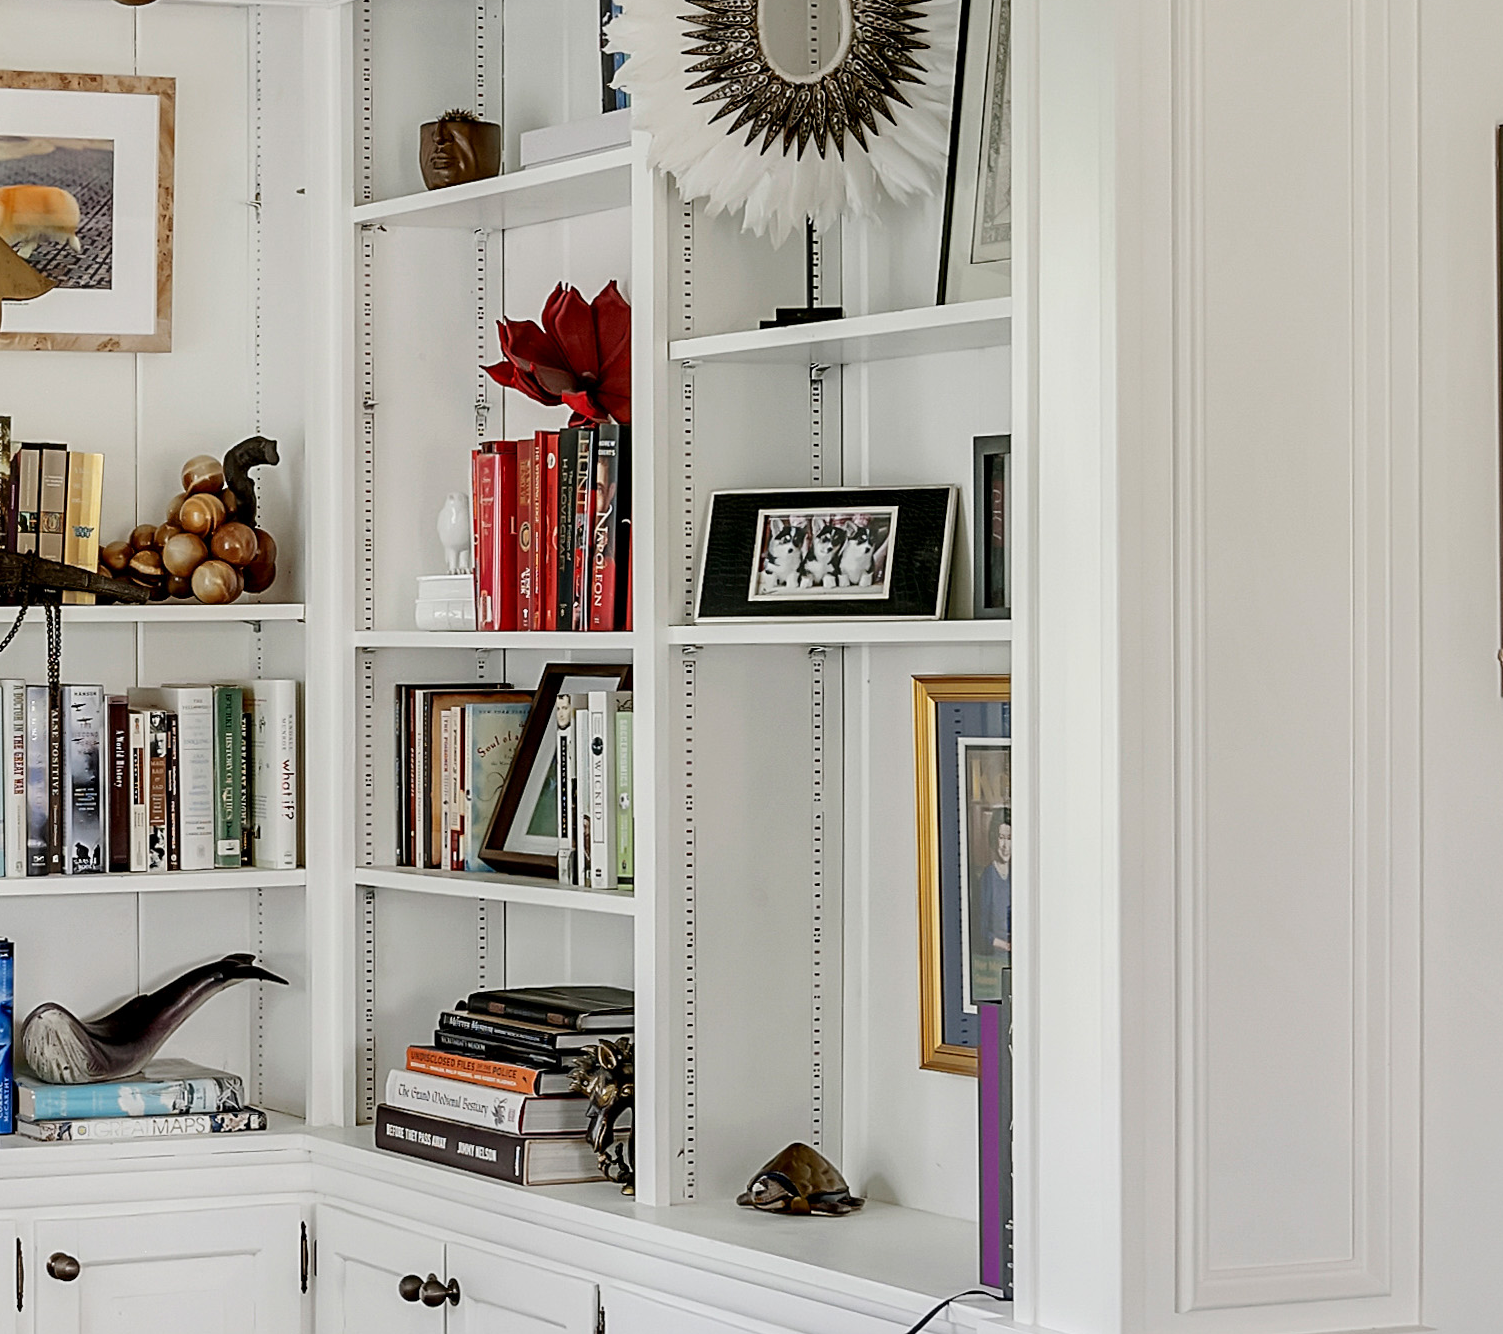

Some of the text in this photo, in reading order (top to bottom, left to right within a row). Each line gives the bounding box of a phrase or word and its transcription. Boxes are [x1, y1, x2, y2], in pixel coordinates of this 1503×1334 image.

[577, 438, 590, 511] HUNT
[559, 486, 567, 573] LOVECRAFT
[594, 505, 613, 606] NAPOLEON
[13, 693, 24, 721] DOCTOR
[13, 723, 24, 732] IN
[13, 735, 24, 749] THE
[51, 708, 59, 796] ALSE POSITIVE
[116, 736, 125, 758] World
[225, 732, 233, 770] HISTORY
[477, 735, 500, 758] Soul
[503, 730, 512, 743] of
[619, 719, 628, 787] SOCCERNOMICS
[13, 751, 24, 775] GREAT
[114, 760, 125, 788] History
[13, 778, 24, 794] WAR
[225, 773, 233, 783] OF
[282, 759, 295, 820] what if?
[594, 760, 602, 821] WICKED
[225, 786, 233, 820] ETHICS
[410, 1051, 456, 1067] UNDISCLOSED
[457, 1060, 475, 1072] FILES
[492, 1067, 517, 1079] POLICE
[398, 1083, 489, 1117] The Grand Medieval Bestiary
[152, 1117, 206, 1135] MAPS
[386, 1123, 447, 1149] BEFORE THEY PASS AWAY
[457, 1141, 497, 1162] JIMMY NELSON
